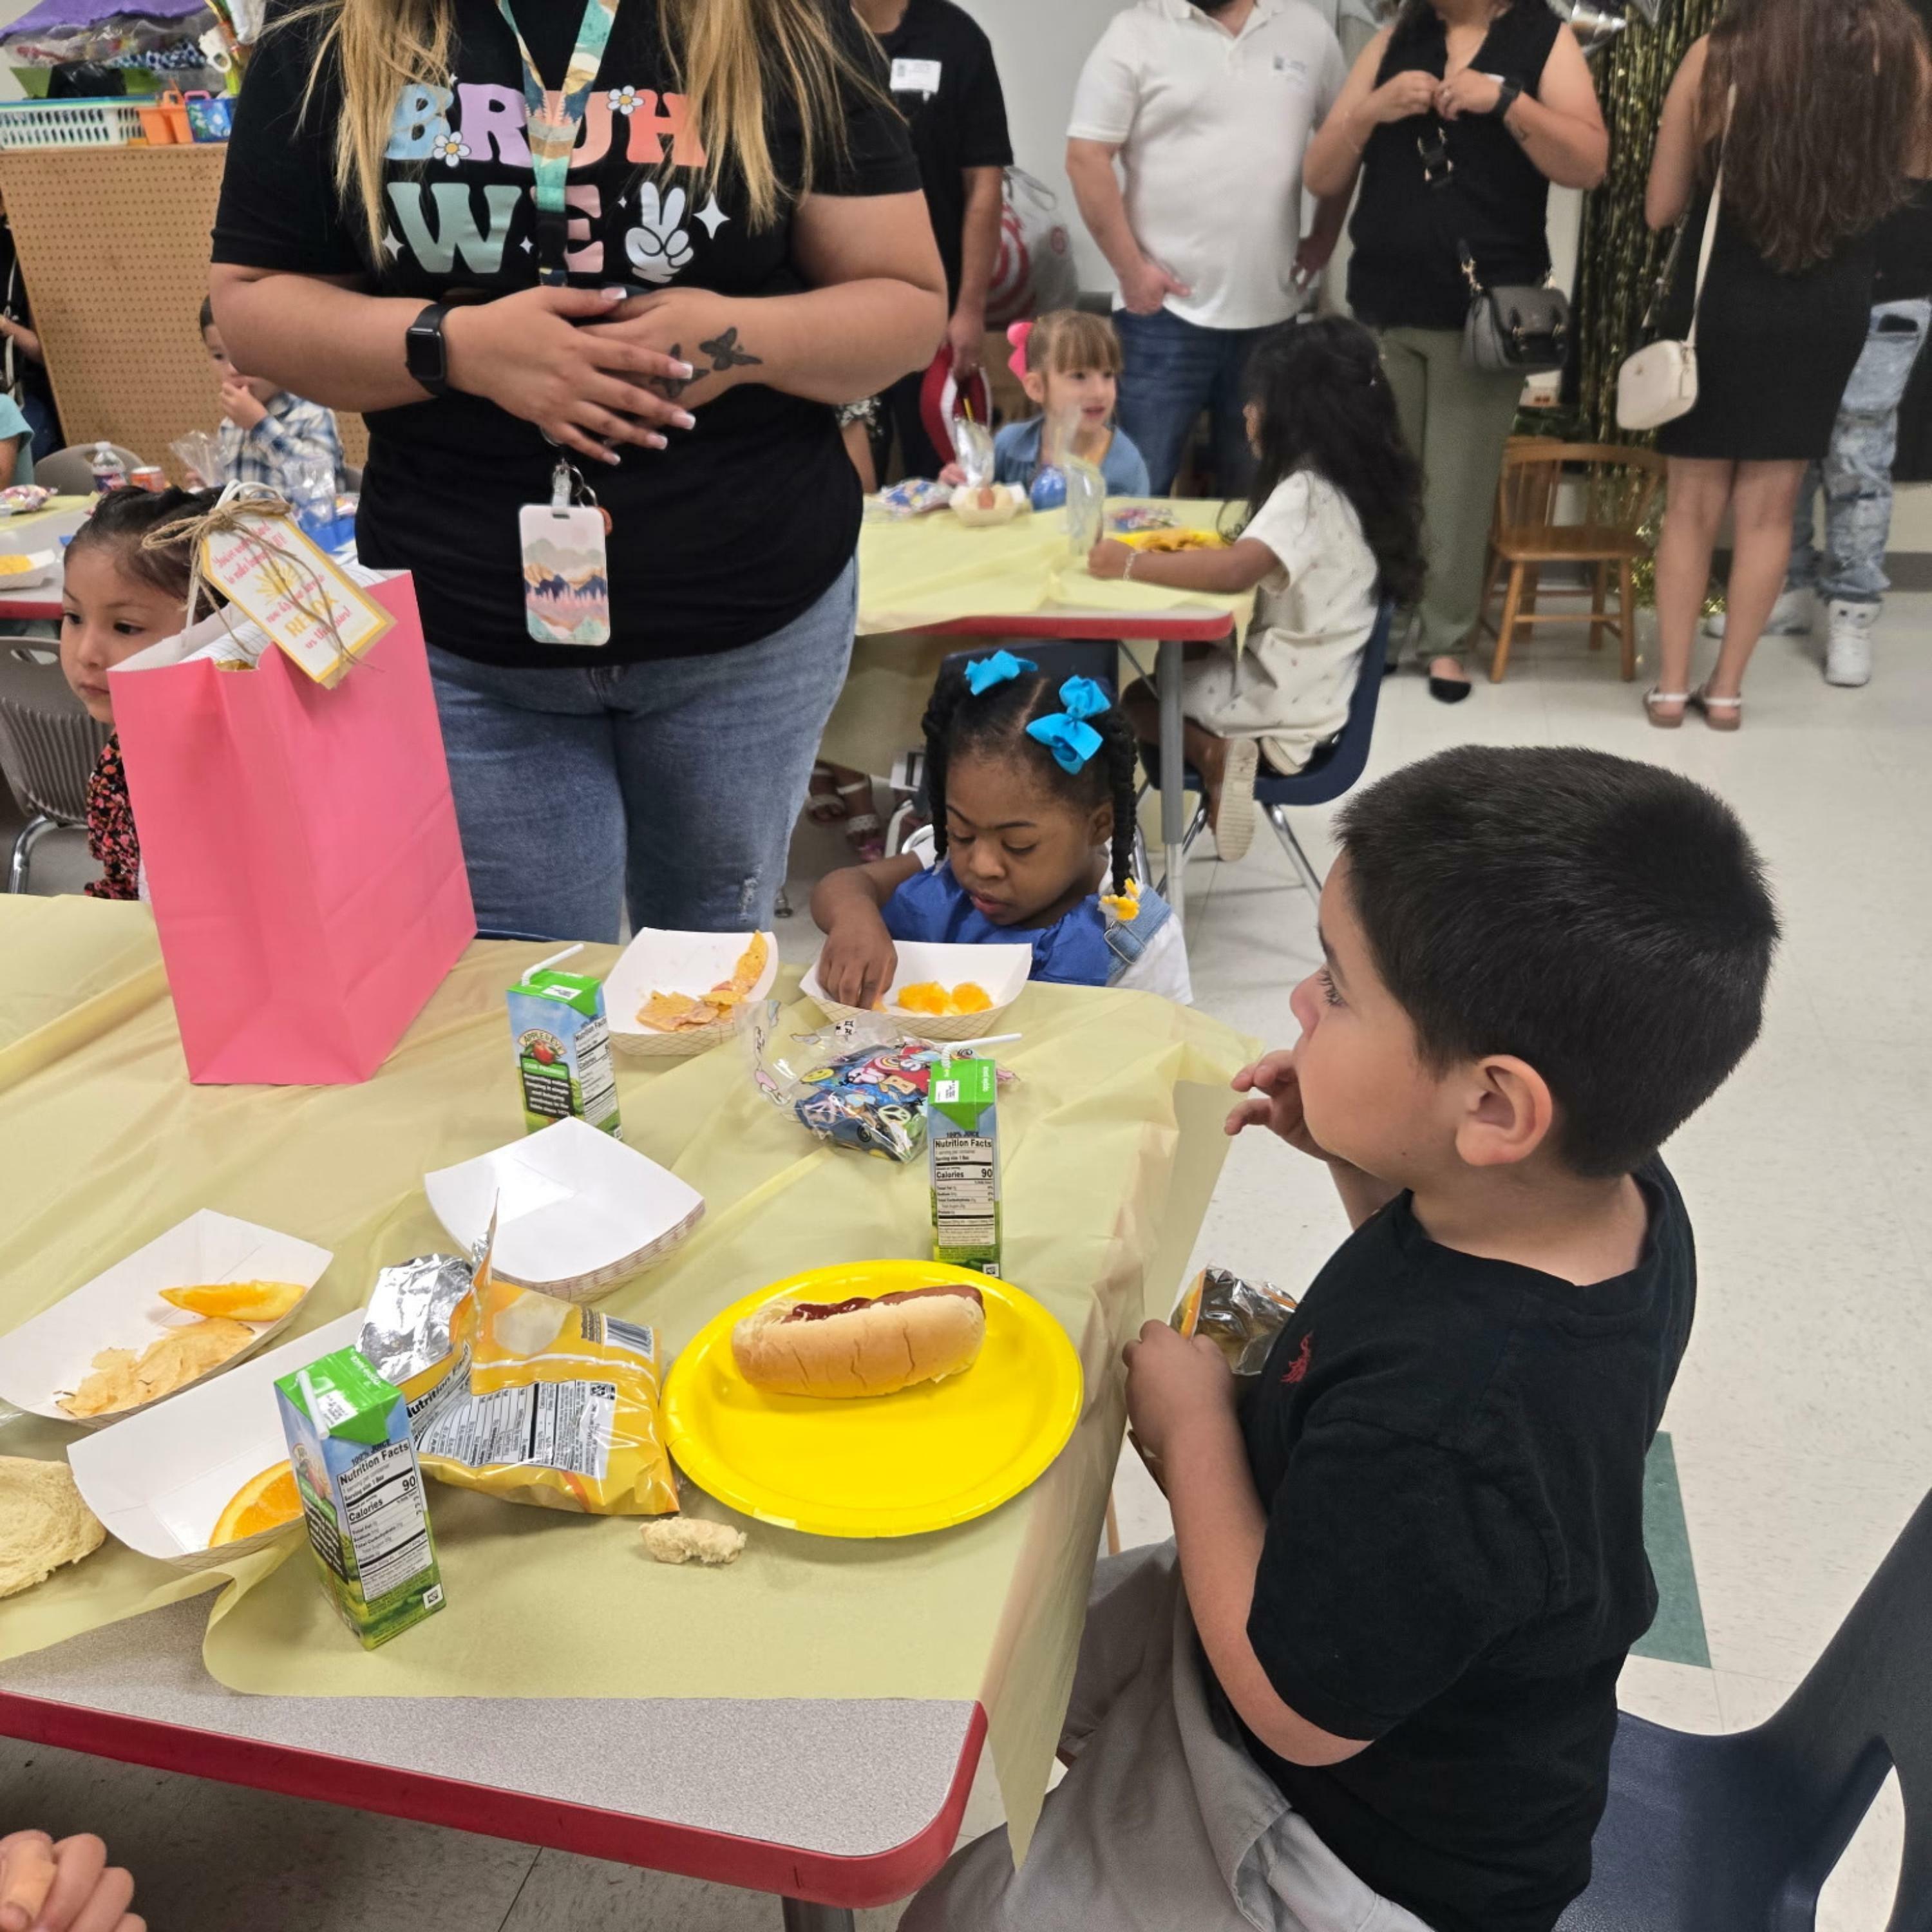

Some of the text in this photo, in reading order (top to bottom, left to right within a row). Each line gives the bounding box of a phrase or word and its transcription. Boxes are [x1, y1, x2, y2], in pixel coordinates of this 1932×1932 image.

[384, 83, 706, 169] BRUH
[387, 182, 605, 274] WE
[935, 1139, 992, 1148] Nutrition Facts
[981, 1168, 993, 1178] 90
[339, 1443, 409, 1485] Nutrition Facts
[348, 1475, 415, 1521] Calories 90
